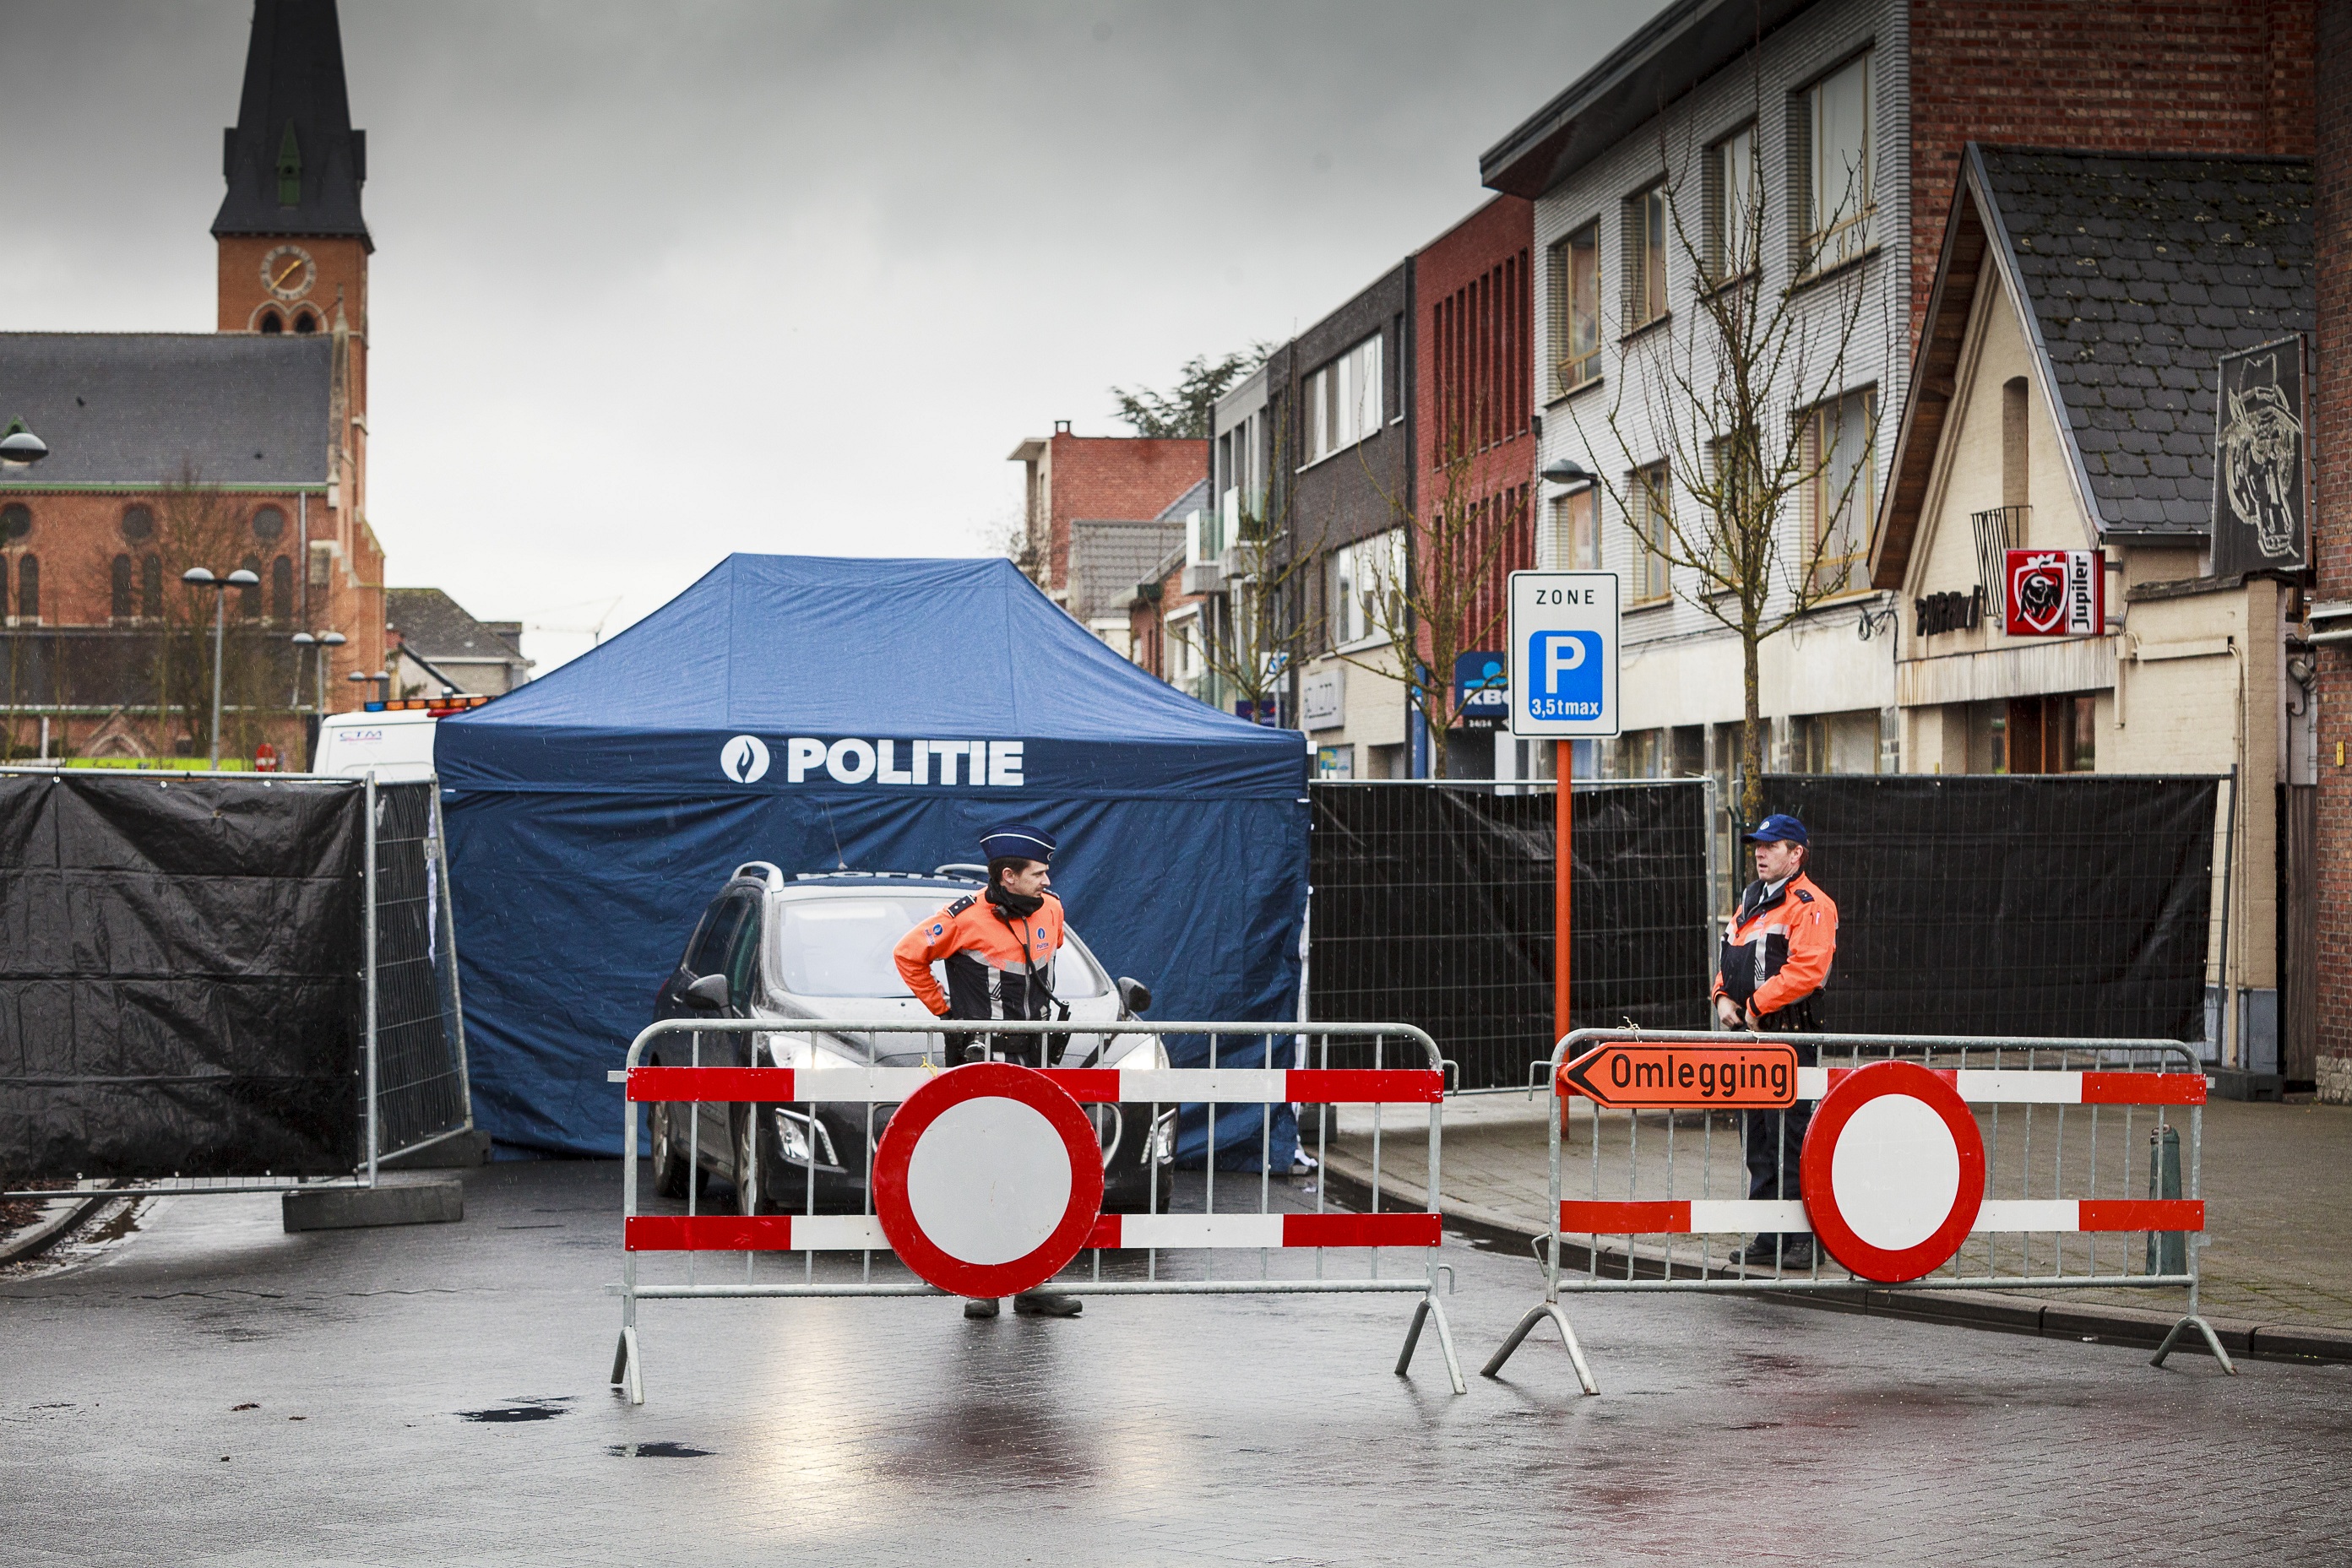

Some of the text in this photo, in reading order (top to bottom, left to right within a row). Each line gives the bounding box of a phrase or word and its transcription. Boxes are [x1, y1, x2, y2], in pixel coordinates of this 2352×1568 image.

[1536, 589, 1594, 605] ZONE
[2072, 556, 2090, 631] Jupiler
[1545, 636, 1586, 694] P
[339, 730, 383, 740] CTM
[787, 737, 1024, 786] POLITIE
[1611, 1054, 1787, 1098] Omlegging
